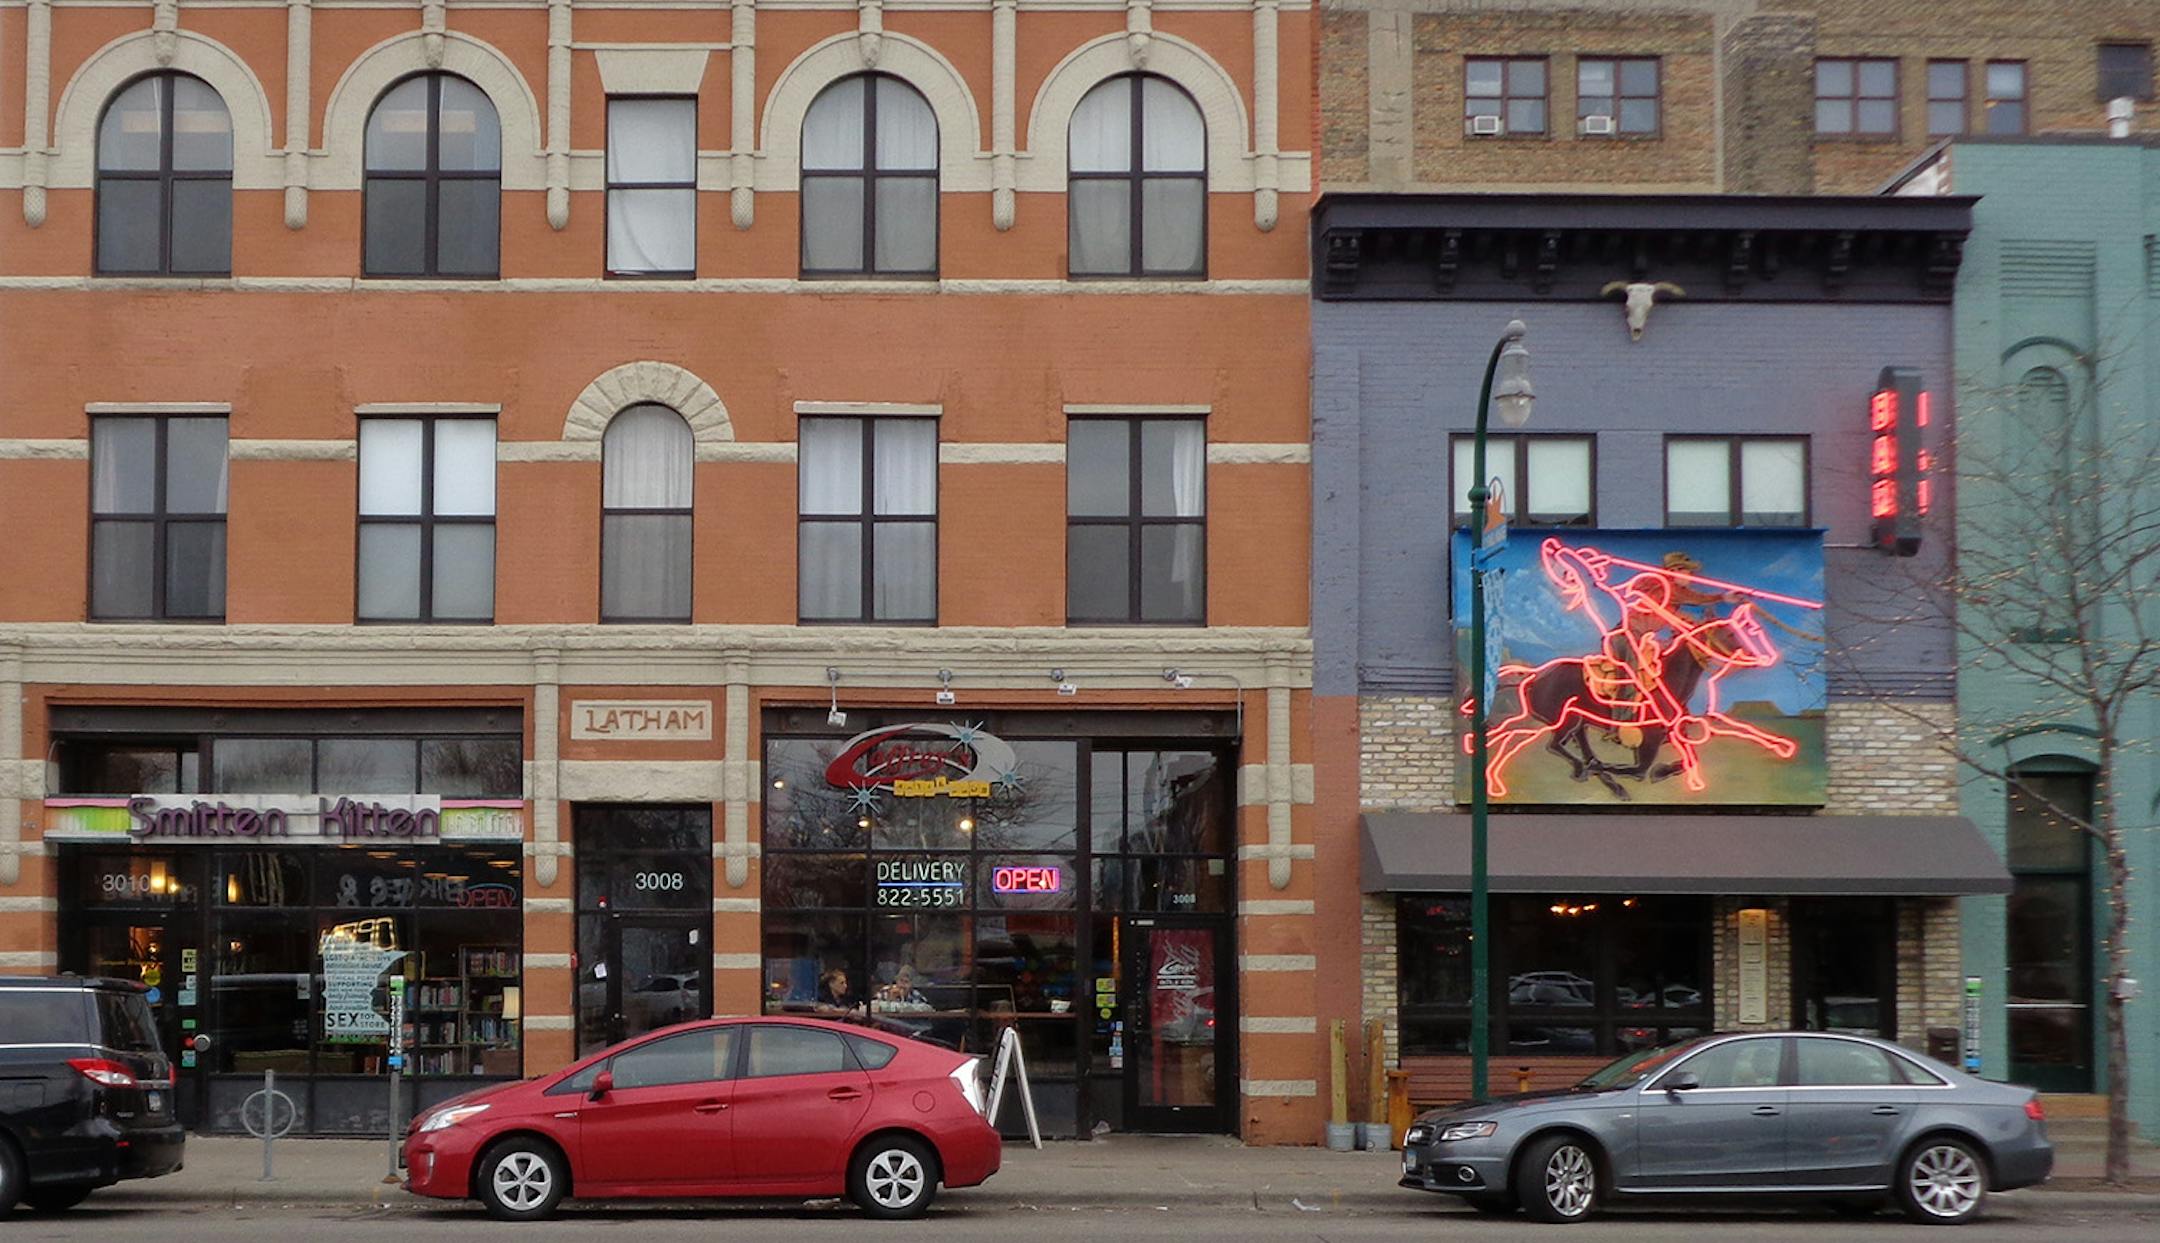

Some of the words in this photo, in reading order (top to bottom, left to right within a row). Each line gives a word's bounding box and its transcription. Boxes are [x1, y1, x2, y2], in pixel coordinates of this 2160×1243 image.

[1871, 390, 1899, 518] BAR
[585, 709, 704, 733] LATHAM
[126, 797, 288, 838] Smitten
[318, 797, 439, 838] Kitten
[635, 872, 684, 890] 3008
[877, 861, 965, 881] DELIVERY
[995, 868, 1057, 891] OPEN
[102, 873, 150, 892] 3010
[456, 888, 514, 908] OPEN
[877, 888, 964, 906] 822-5551
[327, 1012, 359, 1027] SEX
